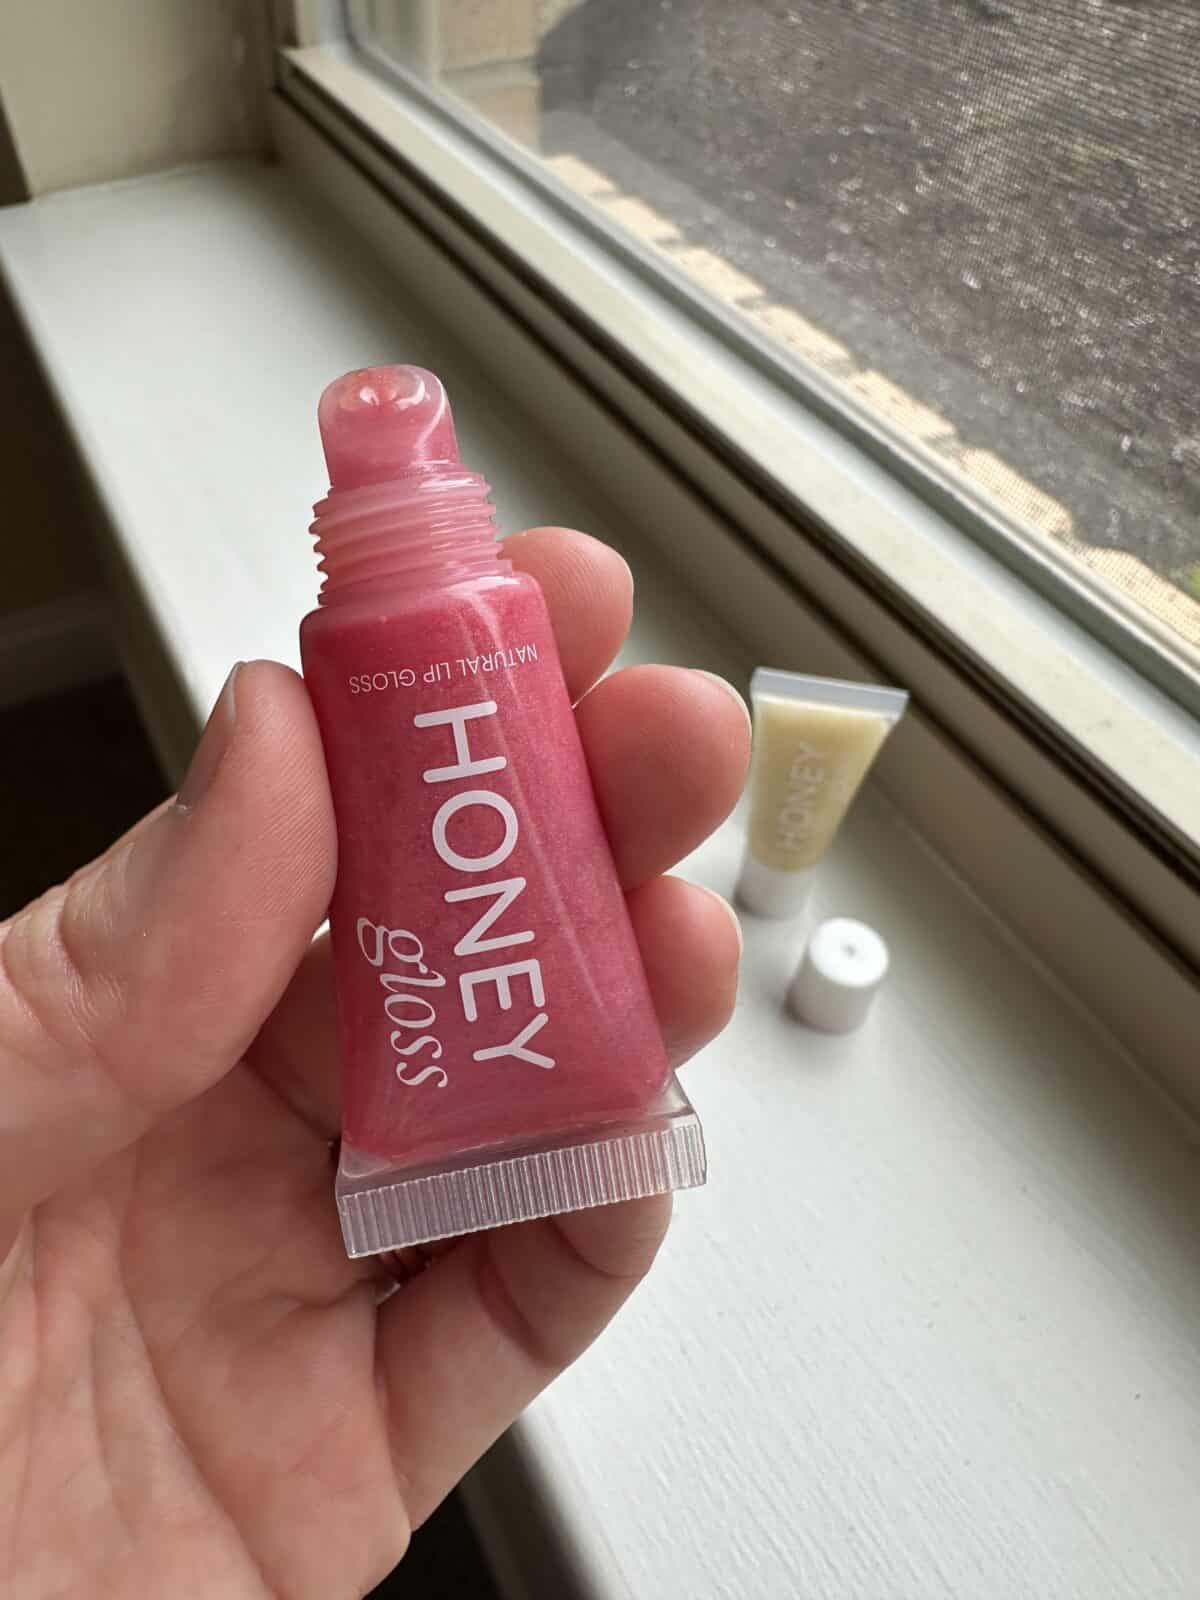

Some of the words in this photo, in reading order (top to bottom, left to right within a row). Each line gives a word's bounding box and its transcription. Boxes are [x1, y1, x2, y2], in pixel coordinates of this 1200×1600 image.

[423, 662, 450, 683] LIP
[456, 643, 538, 676] NATURAL
[349, 668, 416, 694] GLOSS
[413, 700, 556, 1069] HONEY
[356, 916, 448, 1088] gloss
